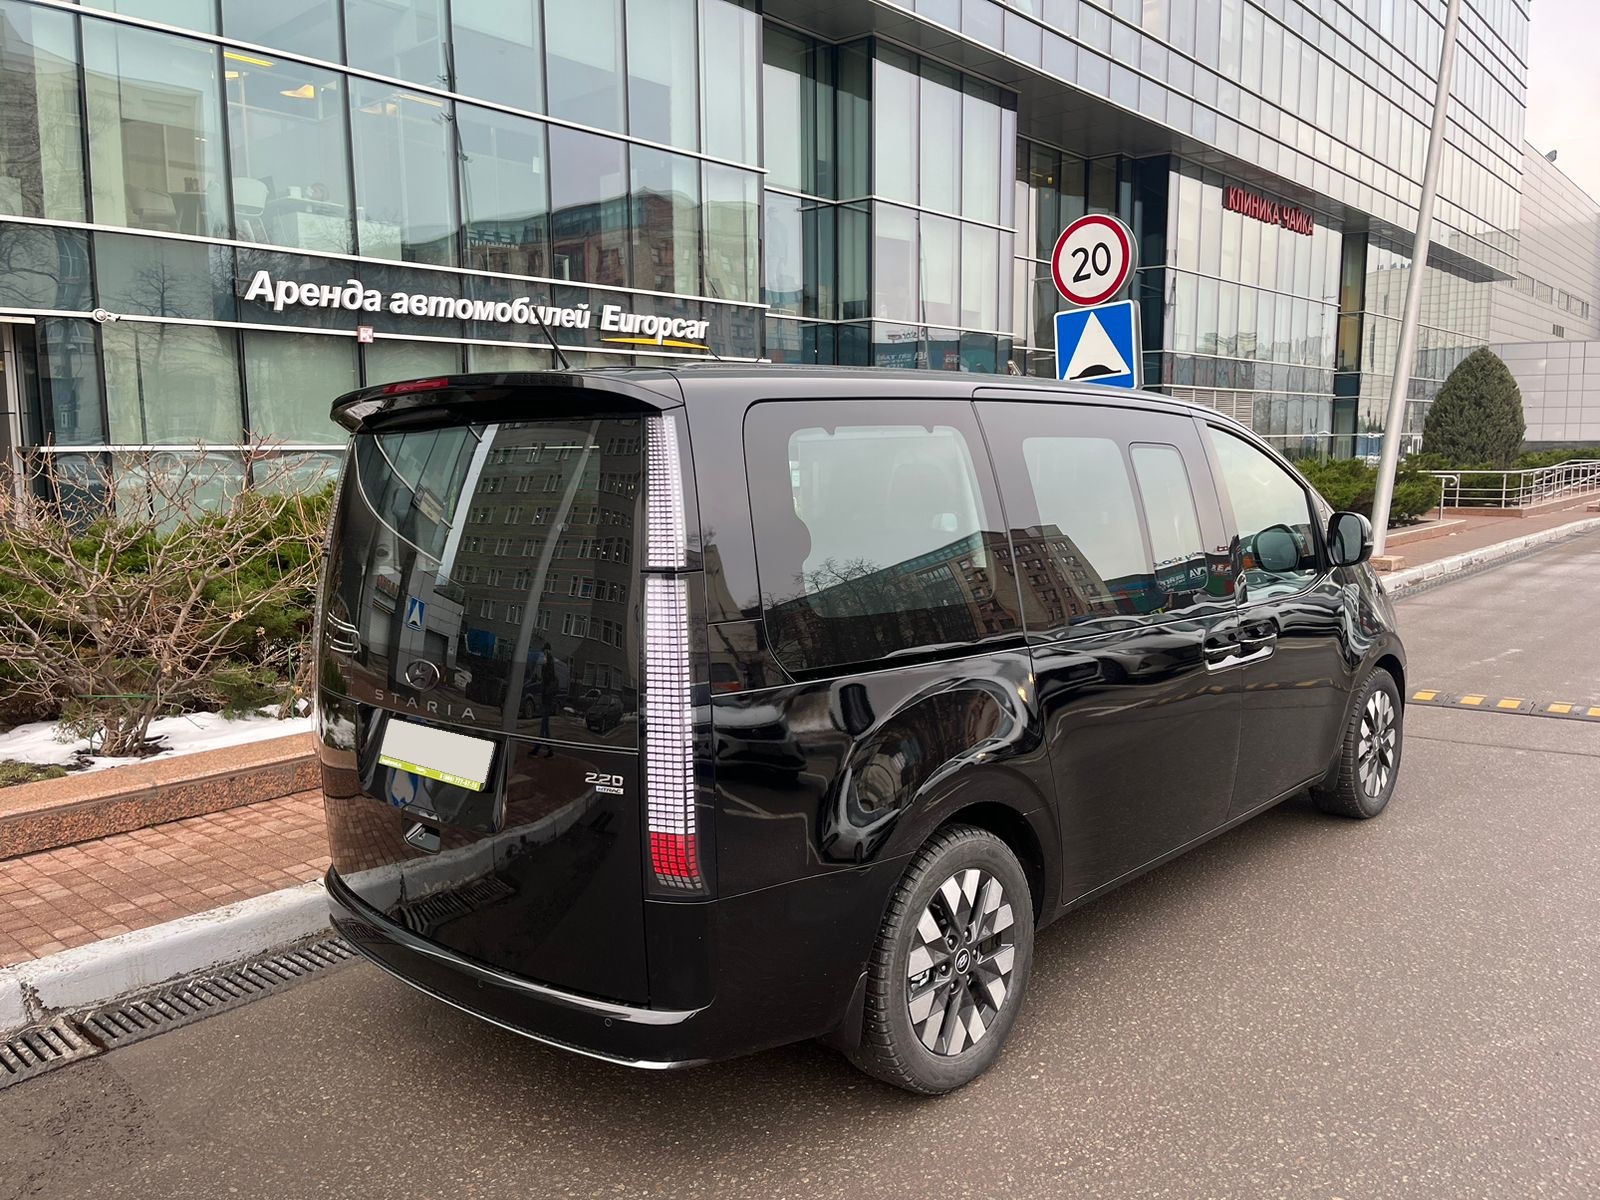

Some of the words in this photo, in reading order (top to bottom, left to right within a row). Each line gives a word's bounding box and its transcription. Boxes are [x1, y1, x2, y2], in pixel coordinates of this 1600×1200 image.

[1229, 185, 1280, 225] КЛИНИКА
[1283, 205, 1313, 235] ЧАЙКА
[1071, 242, 1111, 283] 20
[244, 270, 382, 311] Аренда
[389, 292, 591, 329] автомобилей
[600, 304, 710, 345] Europcar
[374, 688, 476, 721] STARIA
